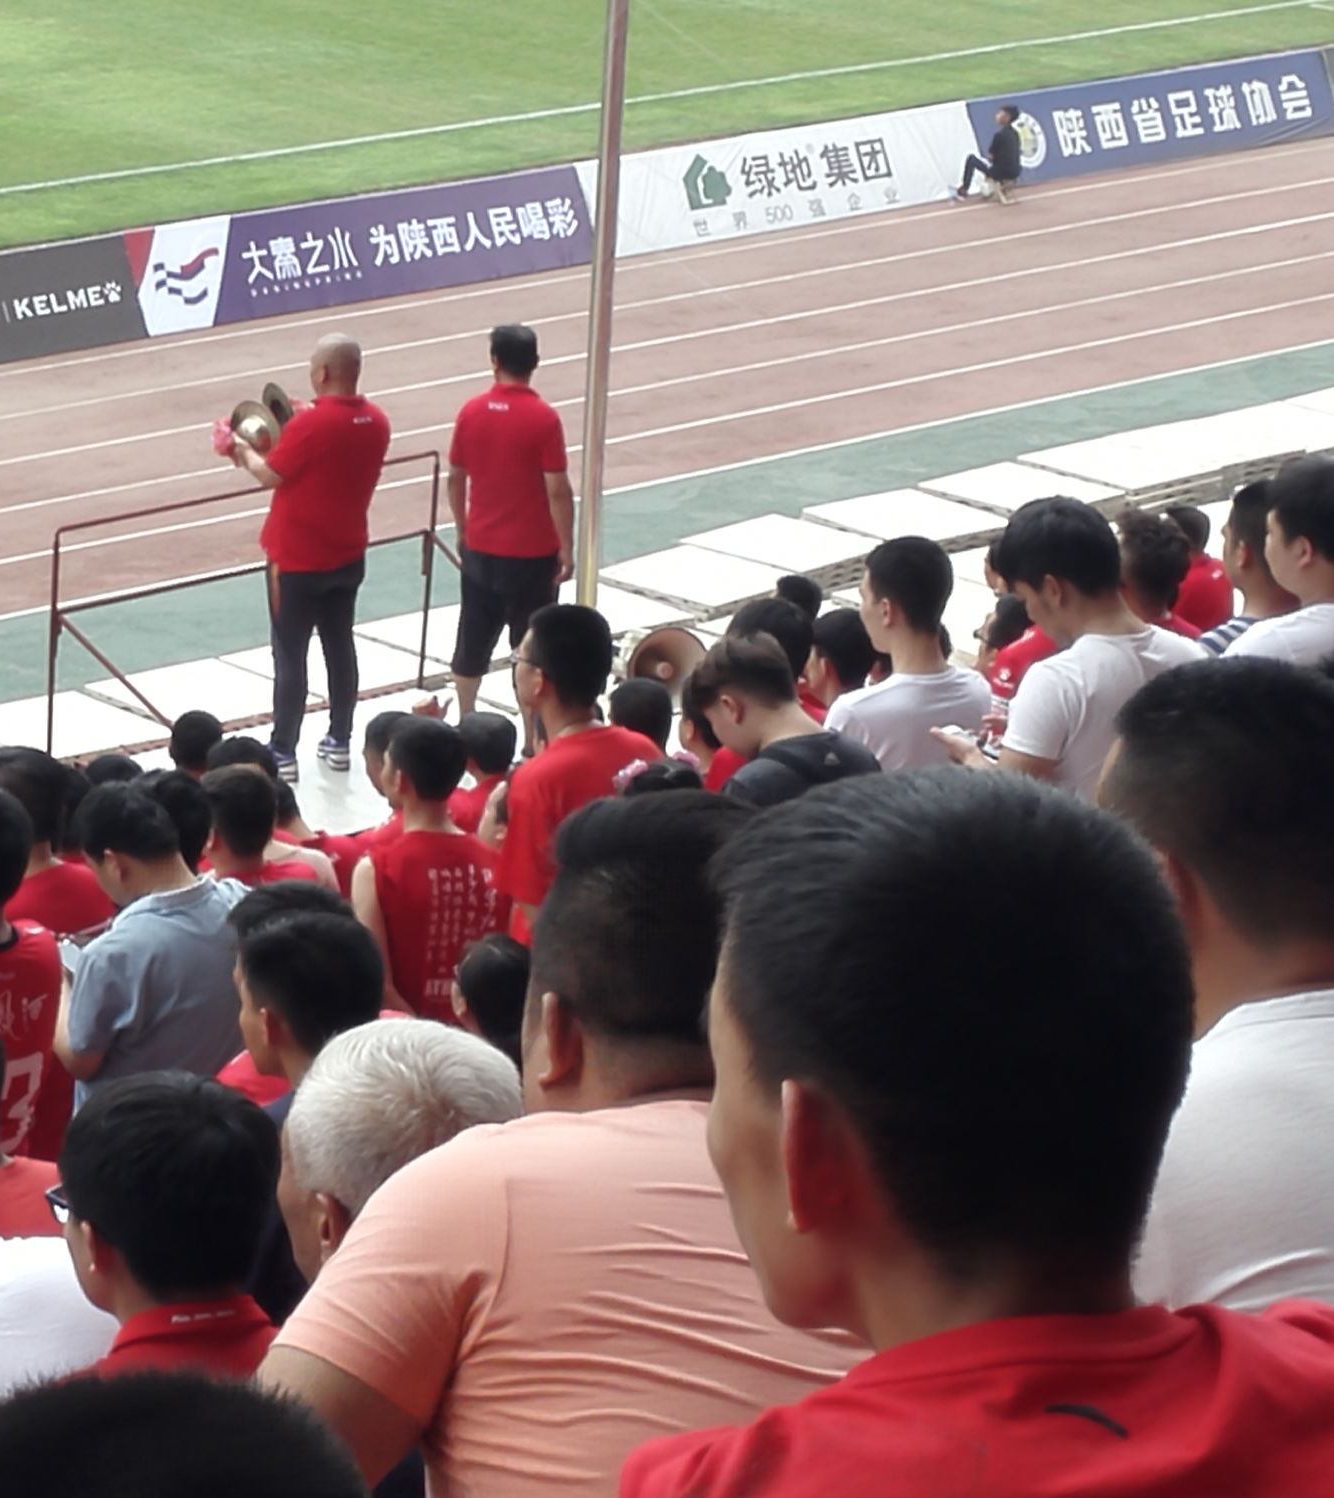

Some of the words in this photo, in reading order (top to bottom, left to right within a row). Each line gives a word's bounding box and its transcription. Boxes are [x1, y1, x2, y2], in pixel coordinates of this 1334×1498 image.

[1052, 74, 1313, 158] 陕西省足球协会
[740, 137, 893, 199] 绿地集团
[369, 197, 579, 267] 为陕西人民喝彩
[13, 286, 106, 320] KELME
